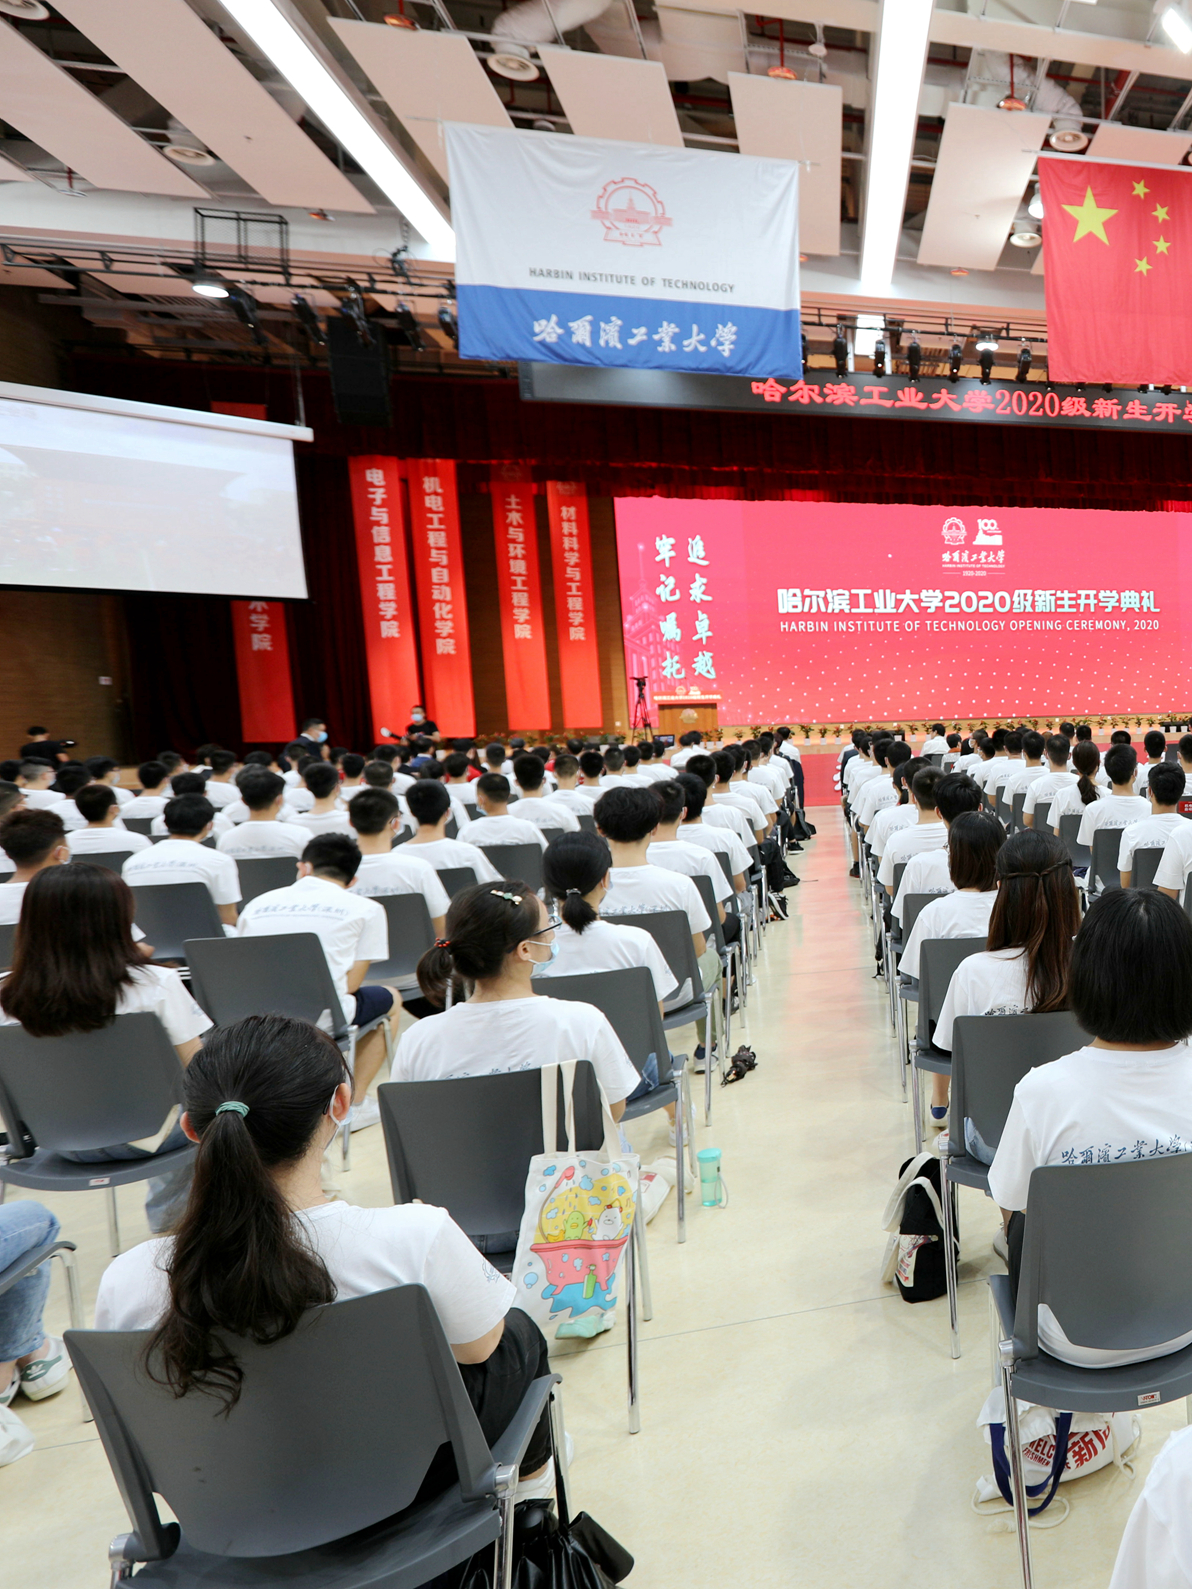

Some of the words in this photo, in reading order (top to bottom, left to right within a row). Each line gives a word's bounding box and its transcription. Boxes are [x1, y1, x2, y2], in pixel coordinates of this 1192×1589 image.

[529, 267, 574, 280] HARBIN
[578, 271, 636, 286] INSTITUTE
[641, 276, 656, 287] OF
[661, 278, 735, 293] TECHNOLOGY
[365, 467, 401, 639] 电子与信息工程学院
[422, 475, 456, 655] 机电工程与自动化学院
[505, 495, 532, 640] 土木与环境工程学院
[560, 505, 586, 641] 材料科学与工程学院
[655, 534, 686, 679] 牢记嘱托
[687, 534, 717, 679] 追求卓越
[776, 588, 1161, 614] 哈尔滨工业大学2020级新生开学典礼
[780, 620, 829, 633] HARBIN
[833, 620, 900, 632] INSTITUTE
[905, 620, 920, 632] OF
[925, 620, 1006, 632] TECHNOLOGY
[1010, 619, 1062, 631] OPENING
[1066, 619, 1130, 632] CEREMONY,
[1134, 619, 1160, 630] 2020
[1022, 1447, 1051, 1467] FRESHMEN
